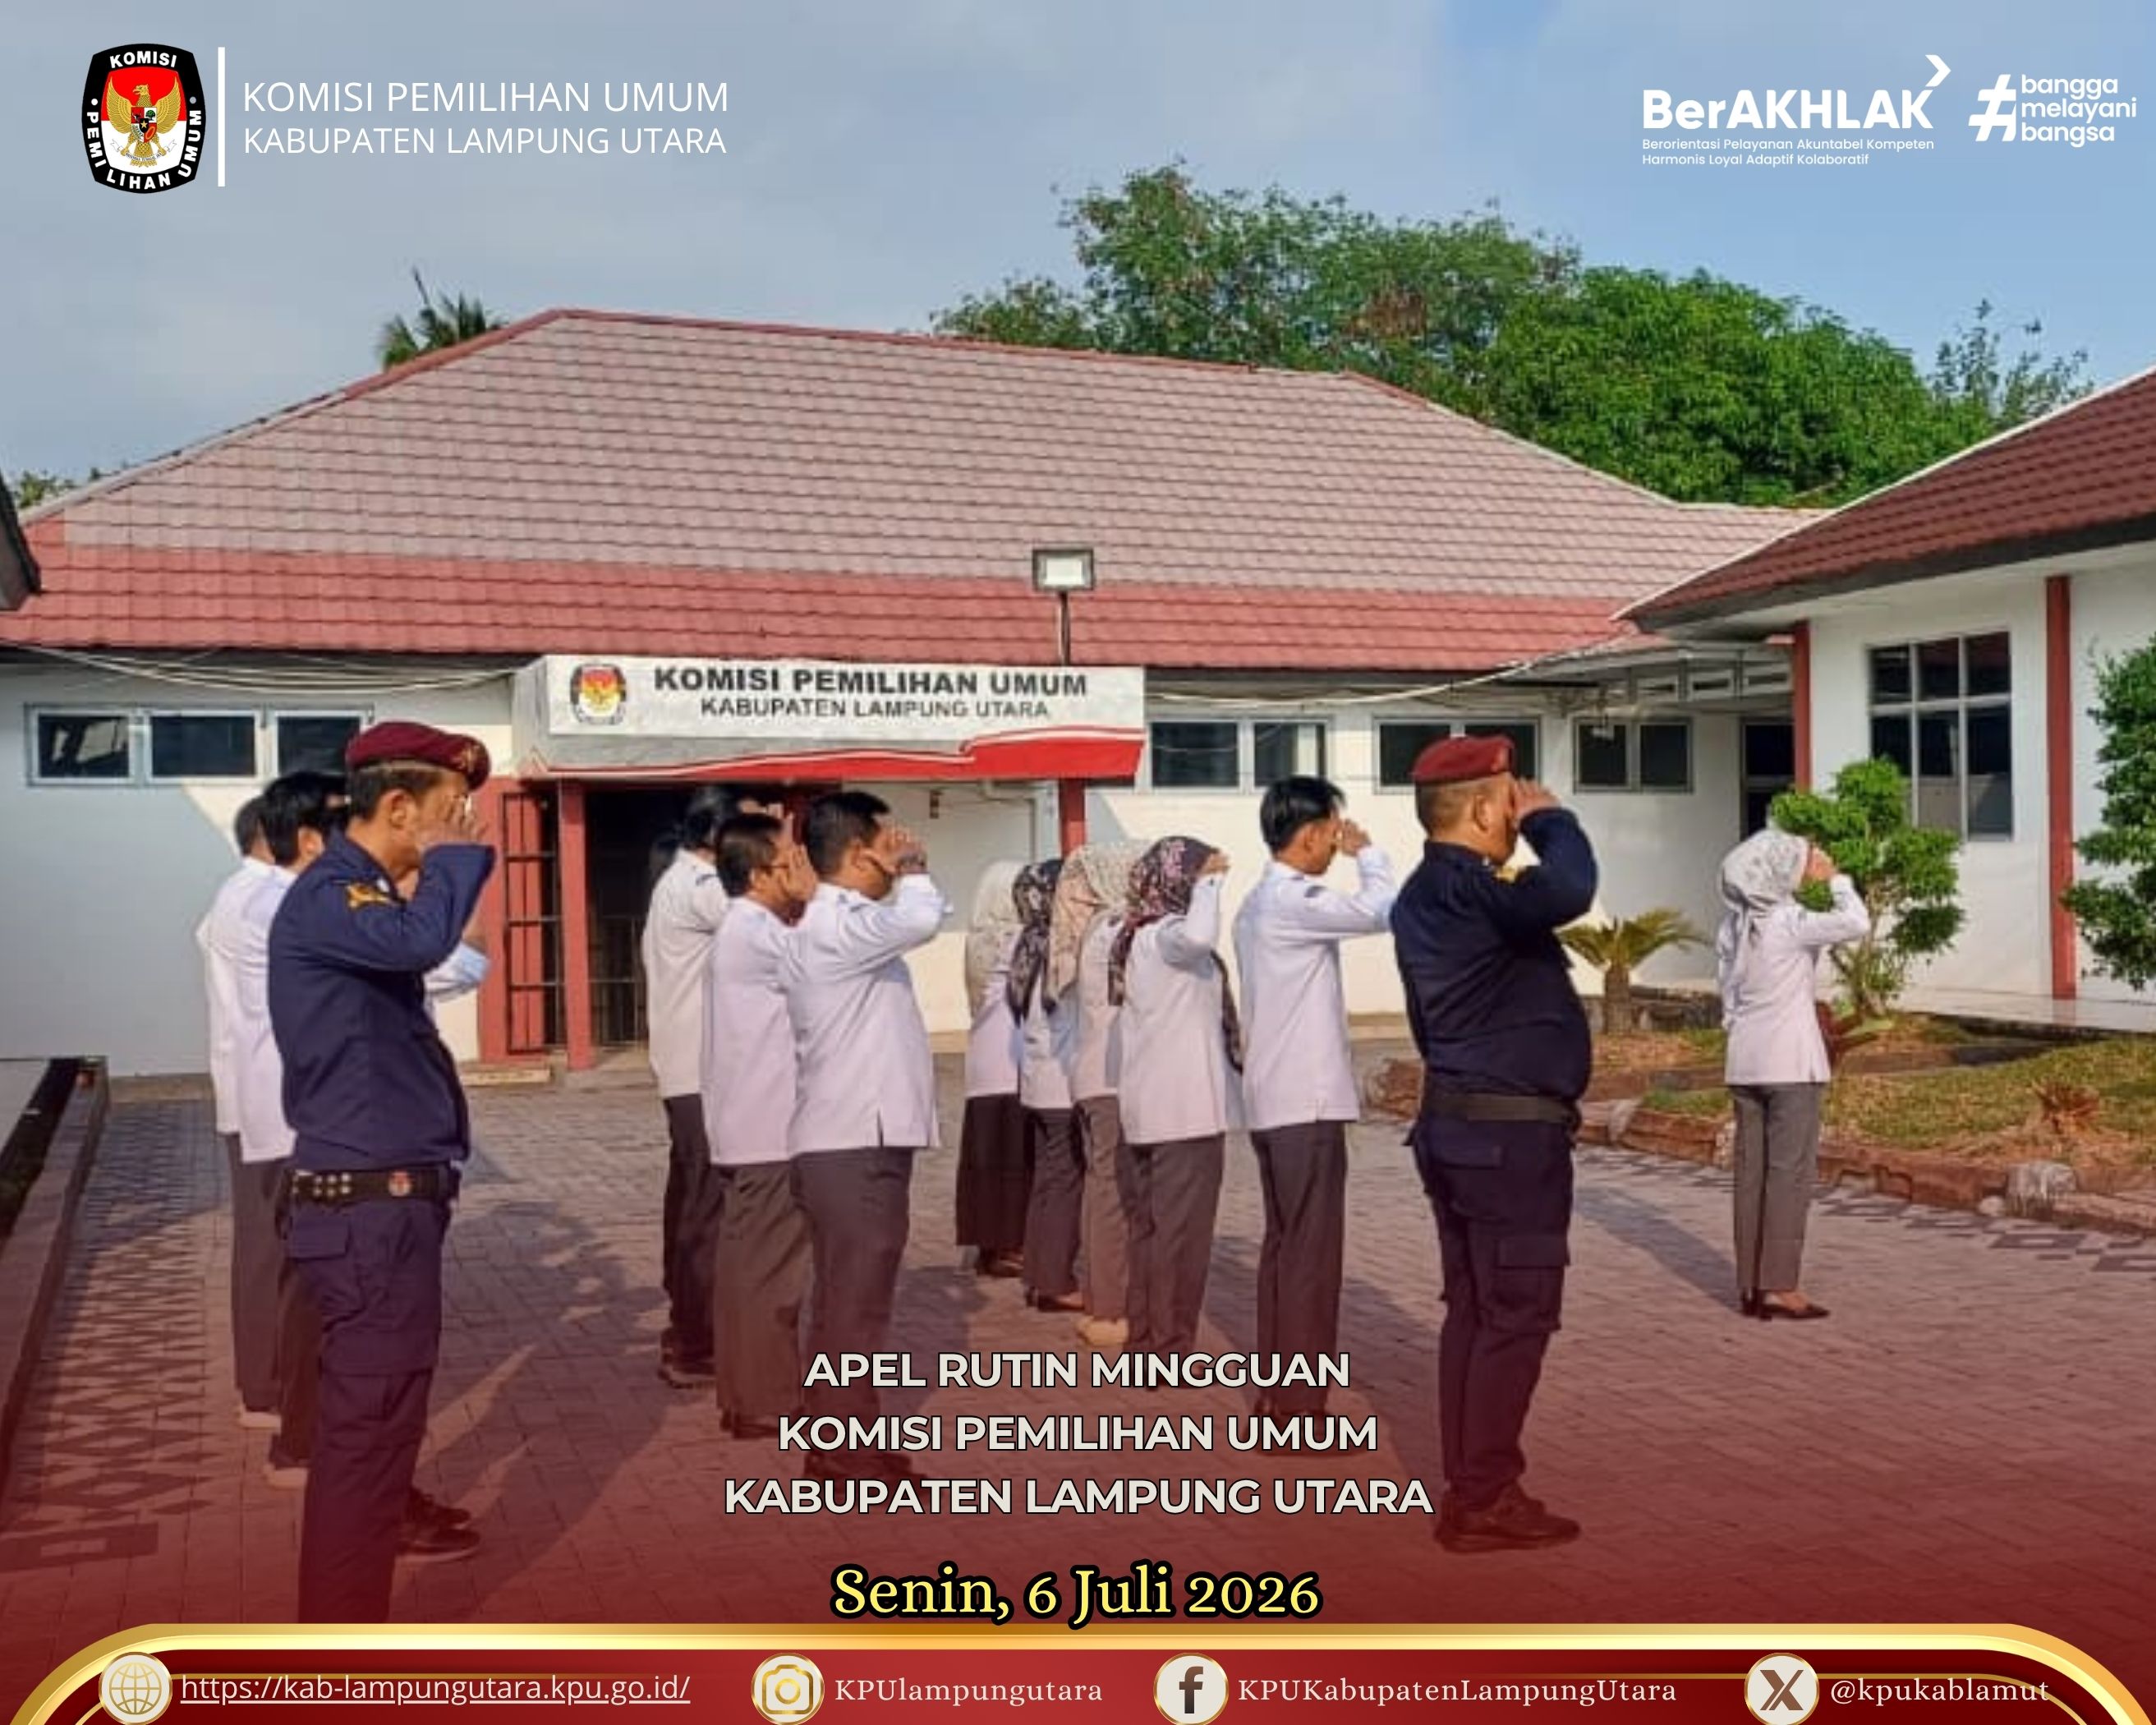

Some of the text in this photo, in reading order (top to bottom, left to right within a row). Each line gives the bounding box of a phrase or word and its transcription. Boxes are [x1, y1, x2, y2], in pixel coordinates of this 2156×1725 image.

[655, 667, 1087, 697] KOMISI PEMILIHAN UMUM
[701, 698, 1049, 718] KABUPATEN LAMPUNG UTARA
